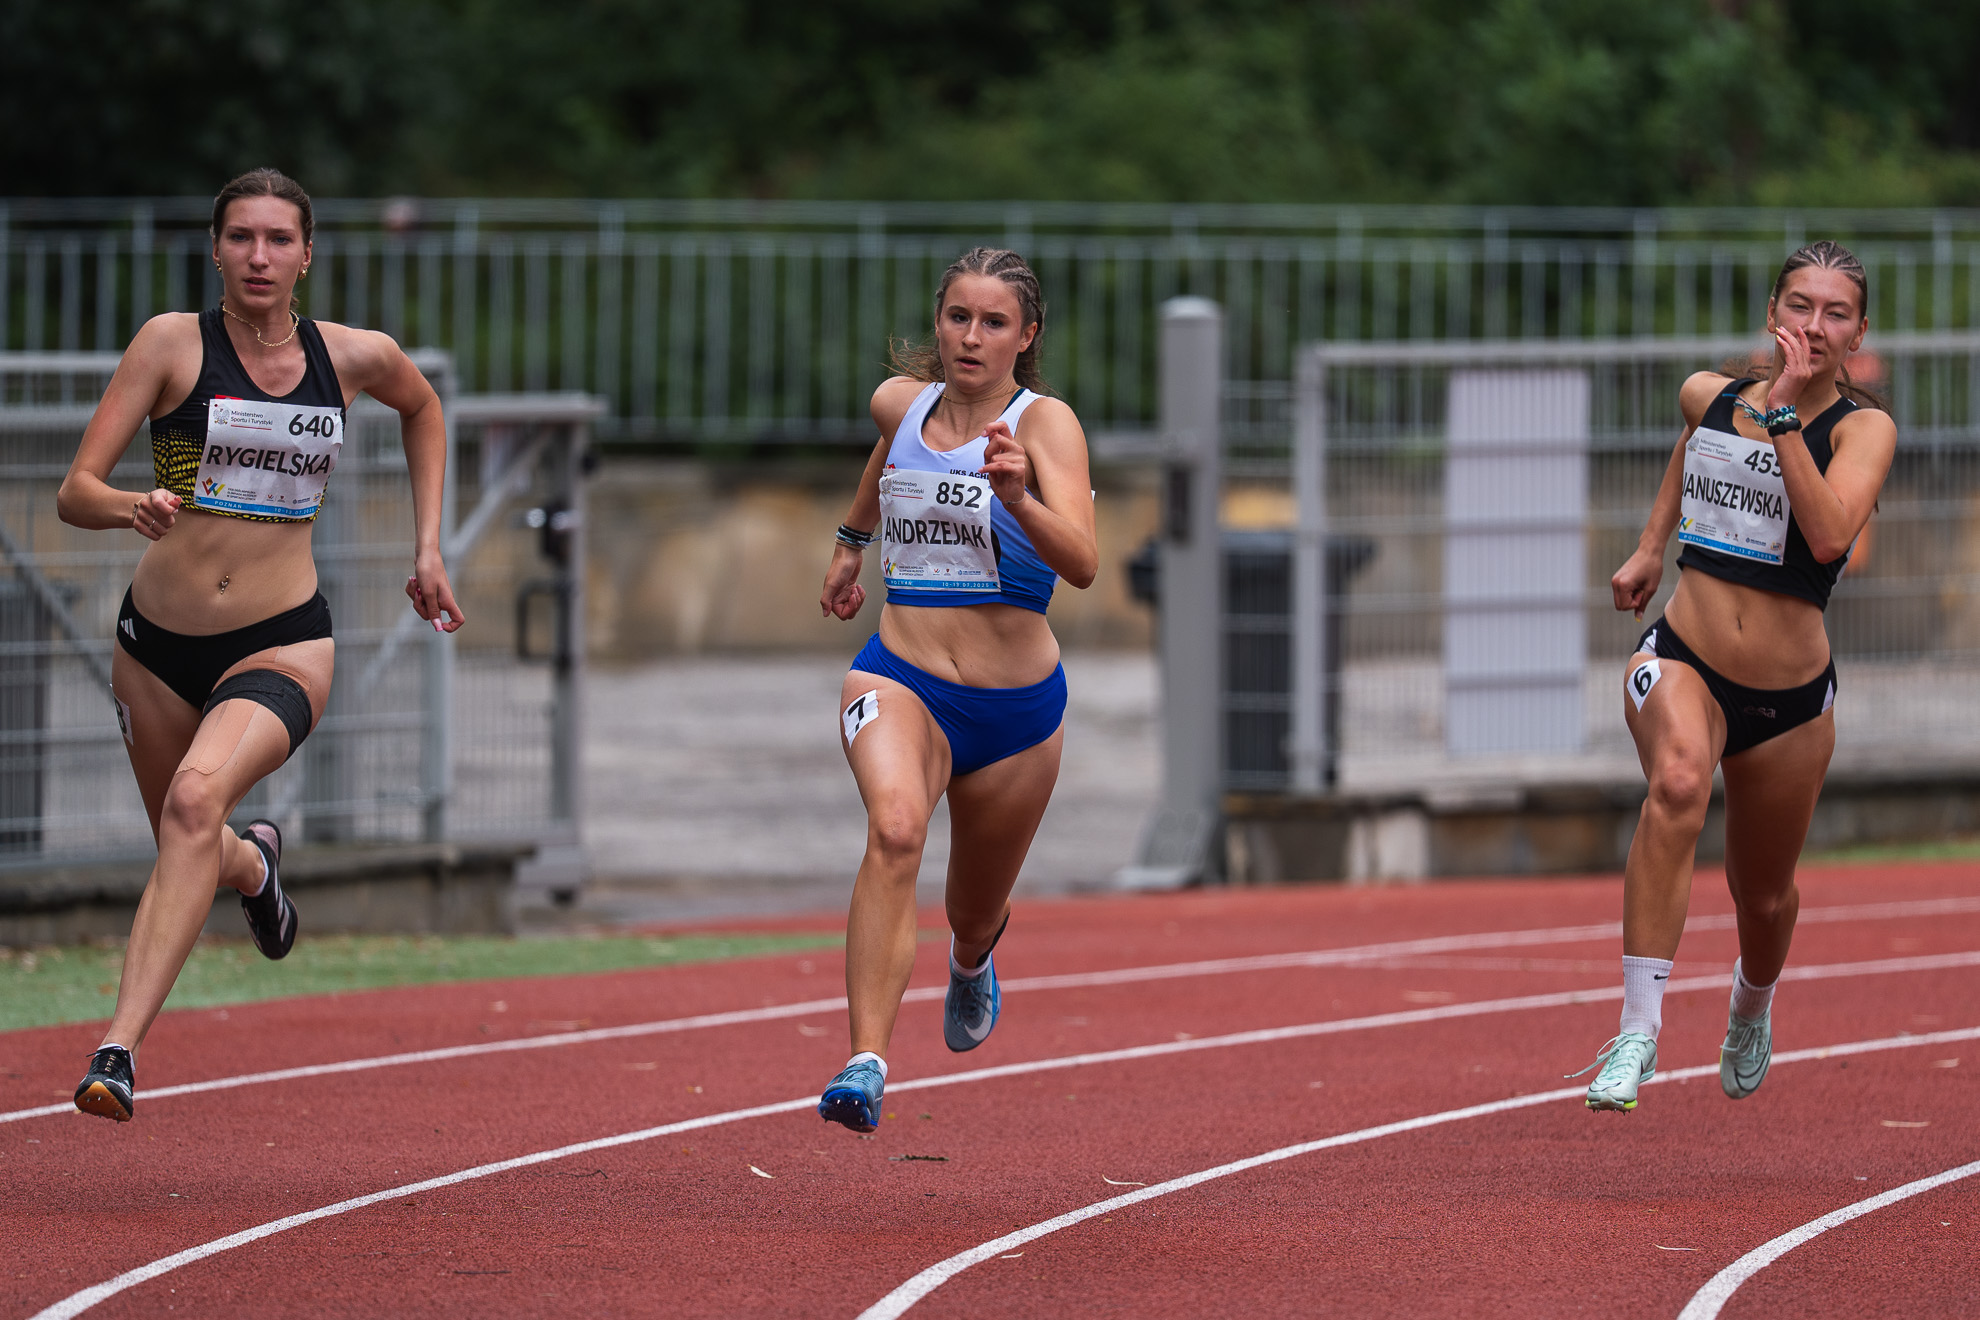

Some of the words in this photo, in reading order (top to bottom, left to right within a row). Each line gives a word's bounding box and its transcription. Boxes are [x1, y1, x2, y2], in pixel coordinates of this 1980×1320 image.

[231, 410, 264, 419] Ministerstwo
[251, 418, 273, 426] Turystyki
[288, 413, 335, 438] 640
[206, 444, 331, 477] RYGIELSKA
[949, 468, 967, 476] UKS
[892, 480, 917, 488] Ministerstwo
[935, 481, 982, 509] 852
[884, 516, 988, 550] ANDRZEJAK
[1634, 665, 1652, 697] 6
[847, 695, 866, 733] 7
